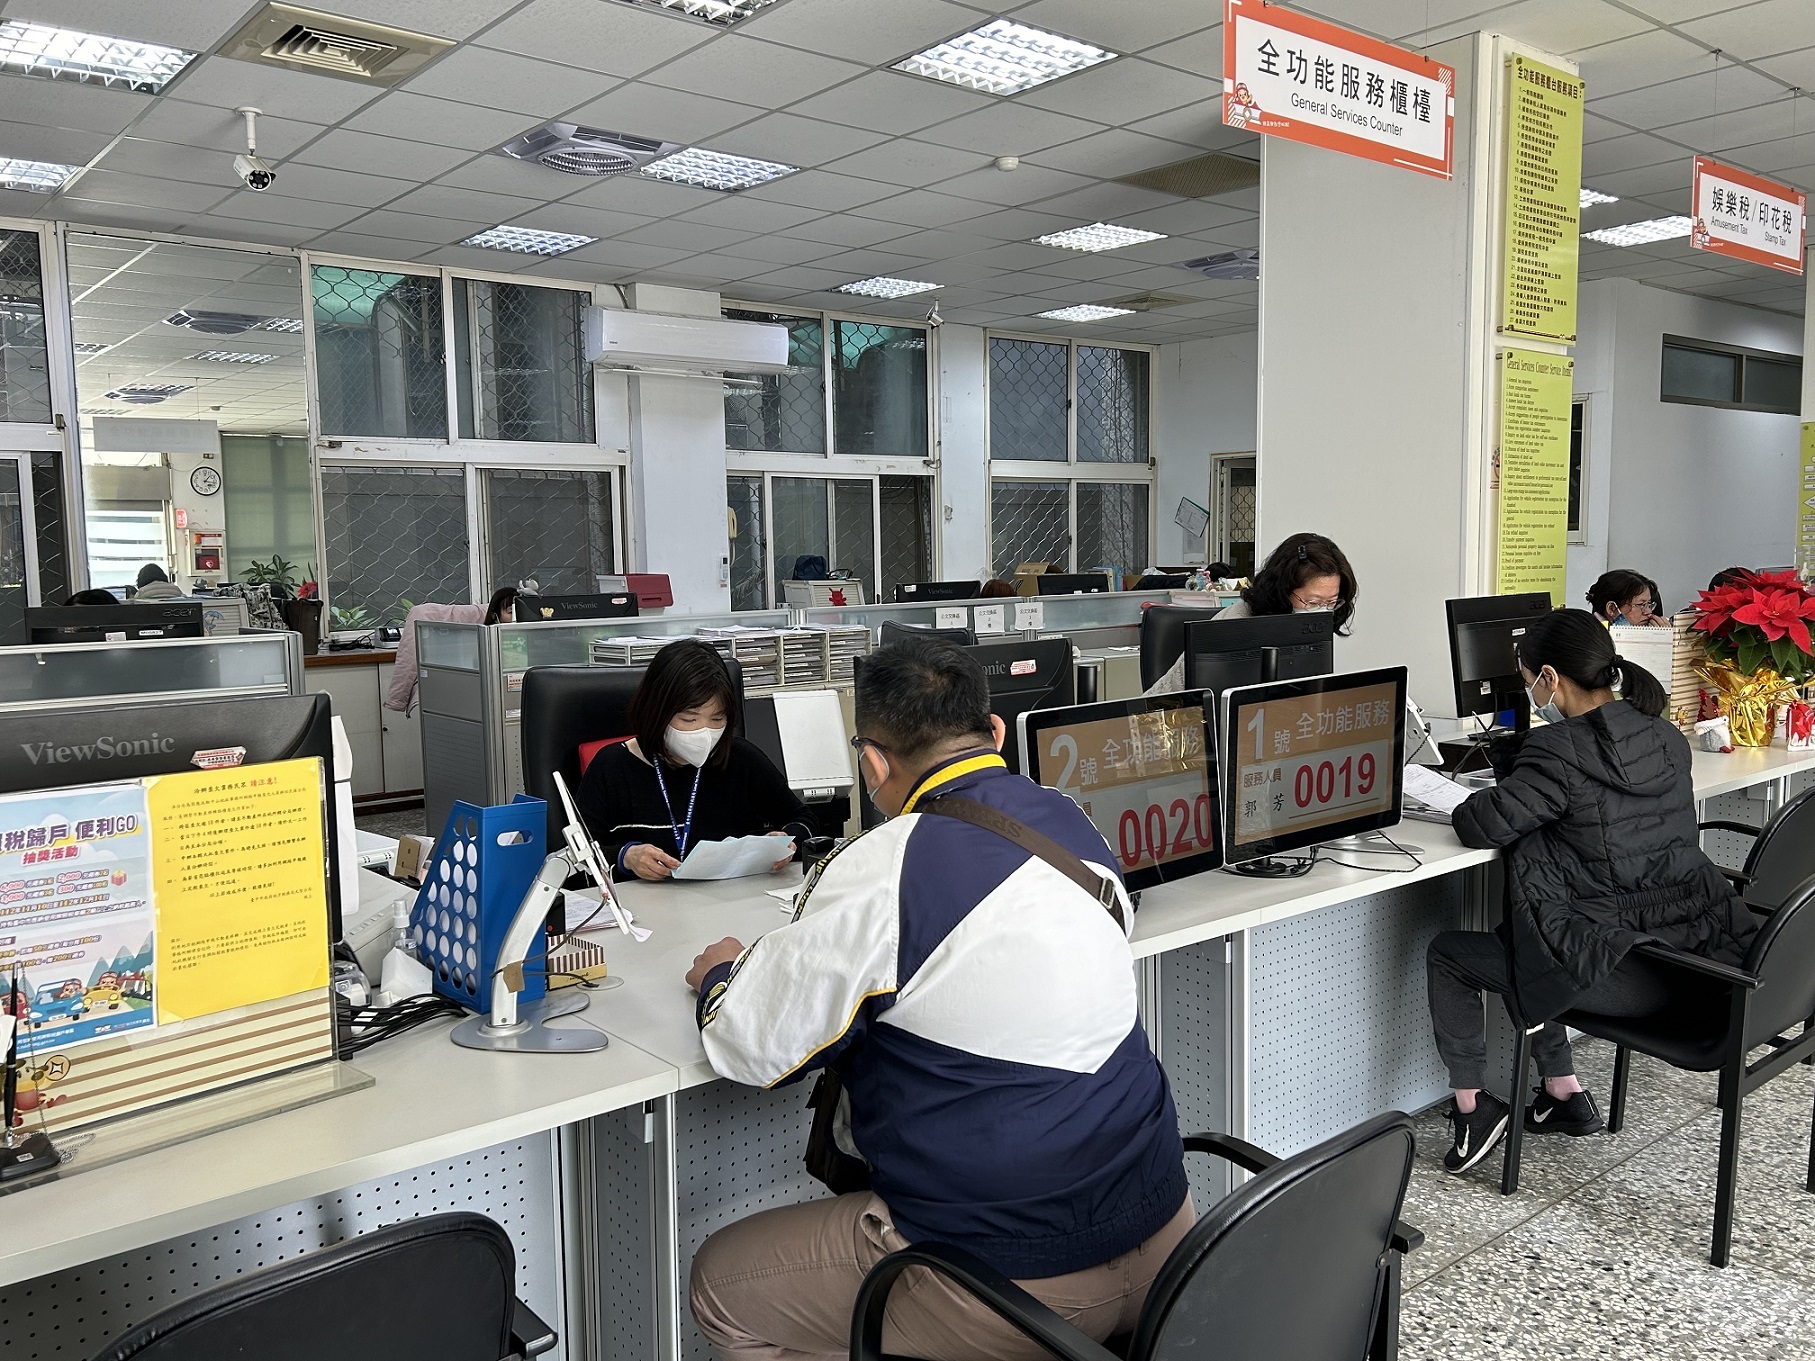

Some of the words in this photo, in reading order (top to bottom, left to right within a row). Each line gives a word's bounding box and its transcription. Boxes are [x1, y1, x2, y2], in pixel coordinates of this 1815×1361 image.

[1257, 39, 1431, 124] 全功能服務櫃檯
[1291, 93, 1328, 115] General
[1331, 104, 1368, 126] Services
[1370, 116, 1403, 137] Counter
[1711, 216, 1739, 233] Amusement
[1740, 222, 1748, 235] Tax
[1764, 232, 1778, 246] Stamp
[1778, 236, 1787, 246] Tax
[163, 608, 194, 617] acer
[561, 602, 598, 610] ViewSonic
[1295, 700, 1391, 741] 全功能服務
[21, 732, 176, 766] ViewSonic
[1243, 768, 1282, 788] 服務人員
[1294, 752, 1376, 808] 0019
[1244, 800, 1257, 817] 郭
[1272, 793, 1285, 811] 芳
[0, 824, 68, 852] 稅歸戶
[1119, 793, 1213, 867] 0020
[22, 846, 80, 865] 抽獎活動
